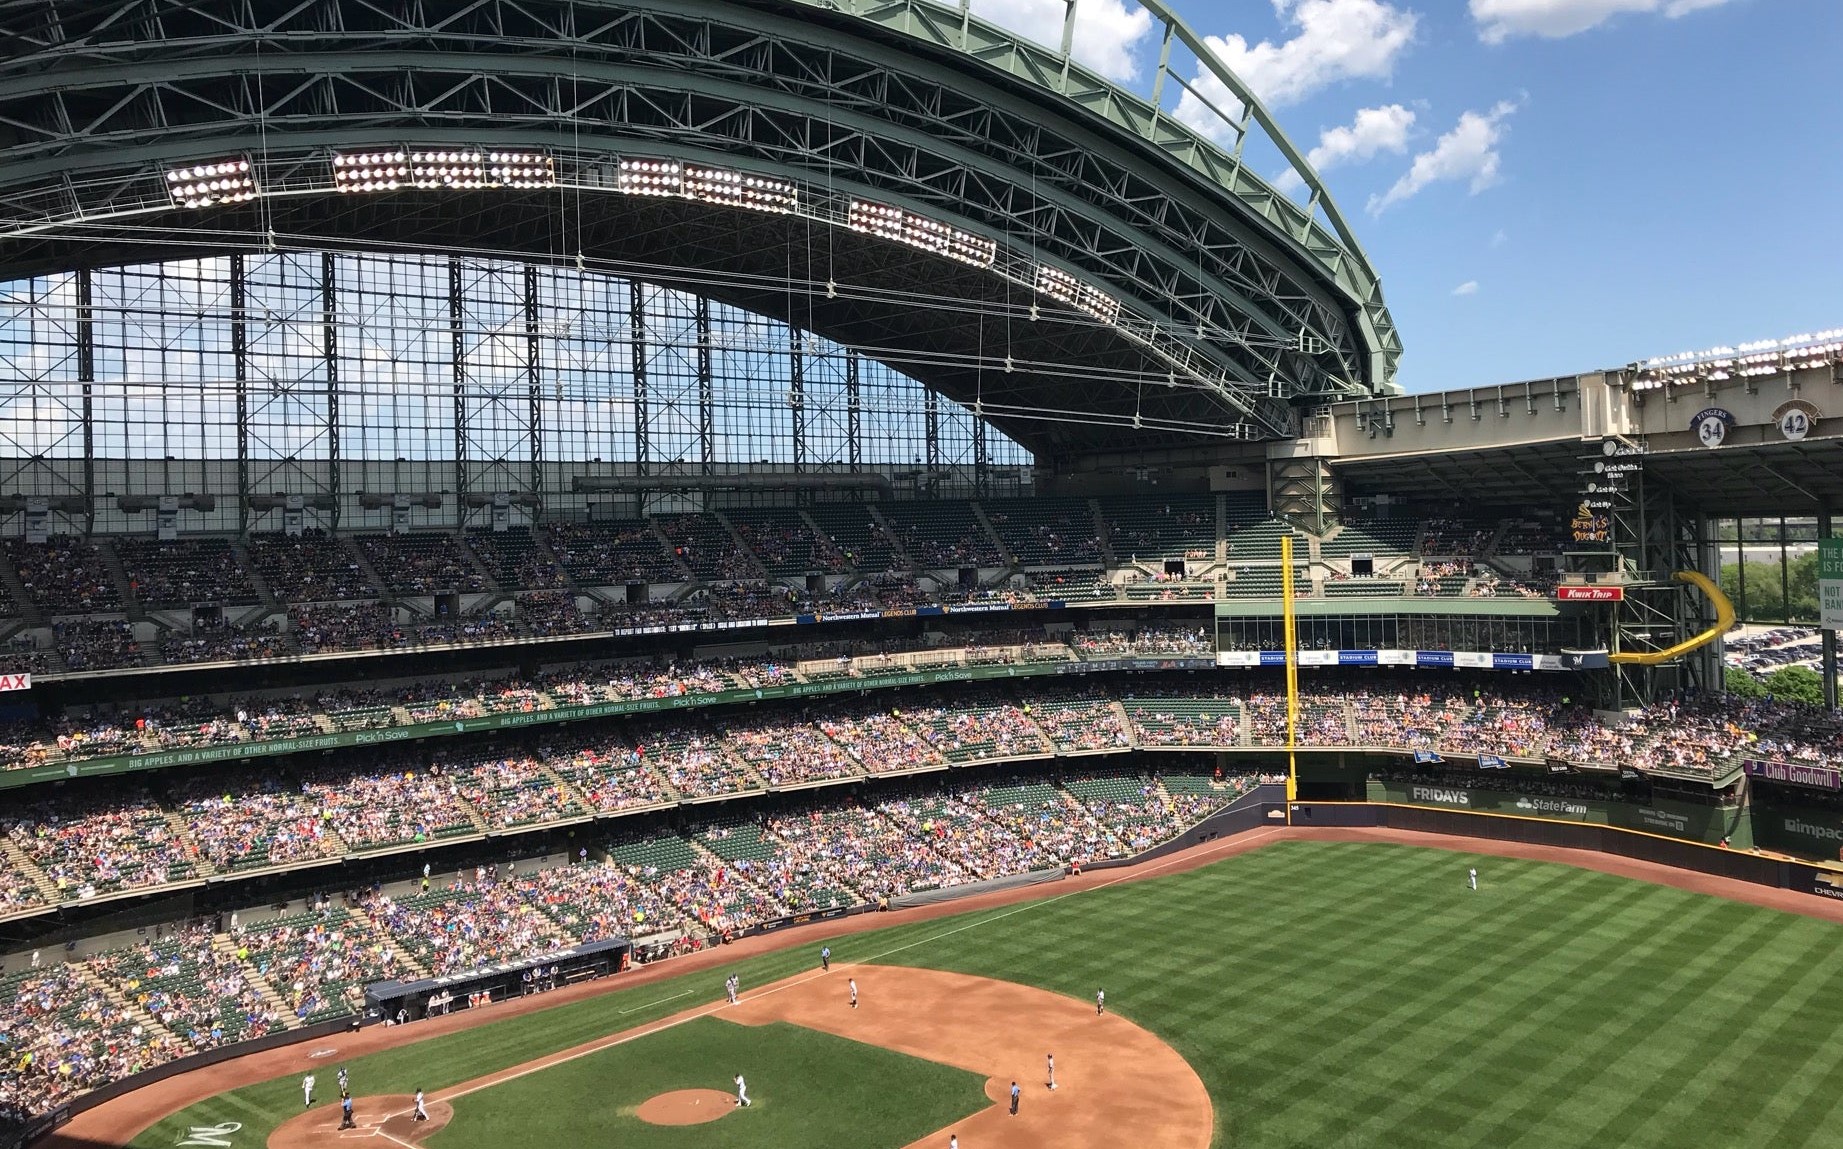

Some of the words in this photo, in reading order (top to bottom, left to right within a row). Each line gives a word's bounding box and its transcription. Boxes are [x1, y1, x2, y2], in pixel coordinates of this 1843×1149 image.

[1696, 410, 1728, 422] FINGERS
[1784, 414, 1806, 434] 42
[1702, 422, 1722, 440] 34
[1822, 548, 1838, 558] THE
[1823, 562, 1832, 572] IS
[1568, 590, 1592, 598] KWIK
[1592, 590, 1612, 598] TRIP
[1824, 586, 1840, 597] NOT
[0, 675, 25, 690] AX
[936, 673, 948, 681] Pick
[674, 698, 690, 707] Pick
[501, 718, 510, 726] BIG
[553, 711, 576, 719] VARIETY
[585, 708, 602, 716] OTHER
[356, 733, 375, 743] Pick
[385, 731, 408, 740] Save
[129, 758, 142, 768] BIG
[178, 753, 192, 763] AND
[202, 749, 231, 759] VARIETY
[234, 748, 241, 756] OF
[245, 745, 266, 755] OTHER
[268, 740, 313, 751] NORMAL-SIZE
[1766, 762, 1786, 780] Club
[1789, 766, 1832, 787] Goodwill
[1413, 787, 1468, 804] FRIDAYS
[1532, 799, 1560, 811] State
[1560, 801, 1586, 814] Farm
